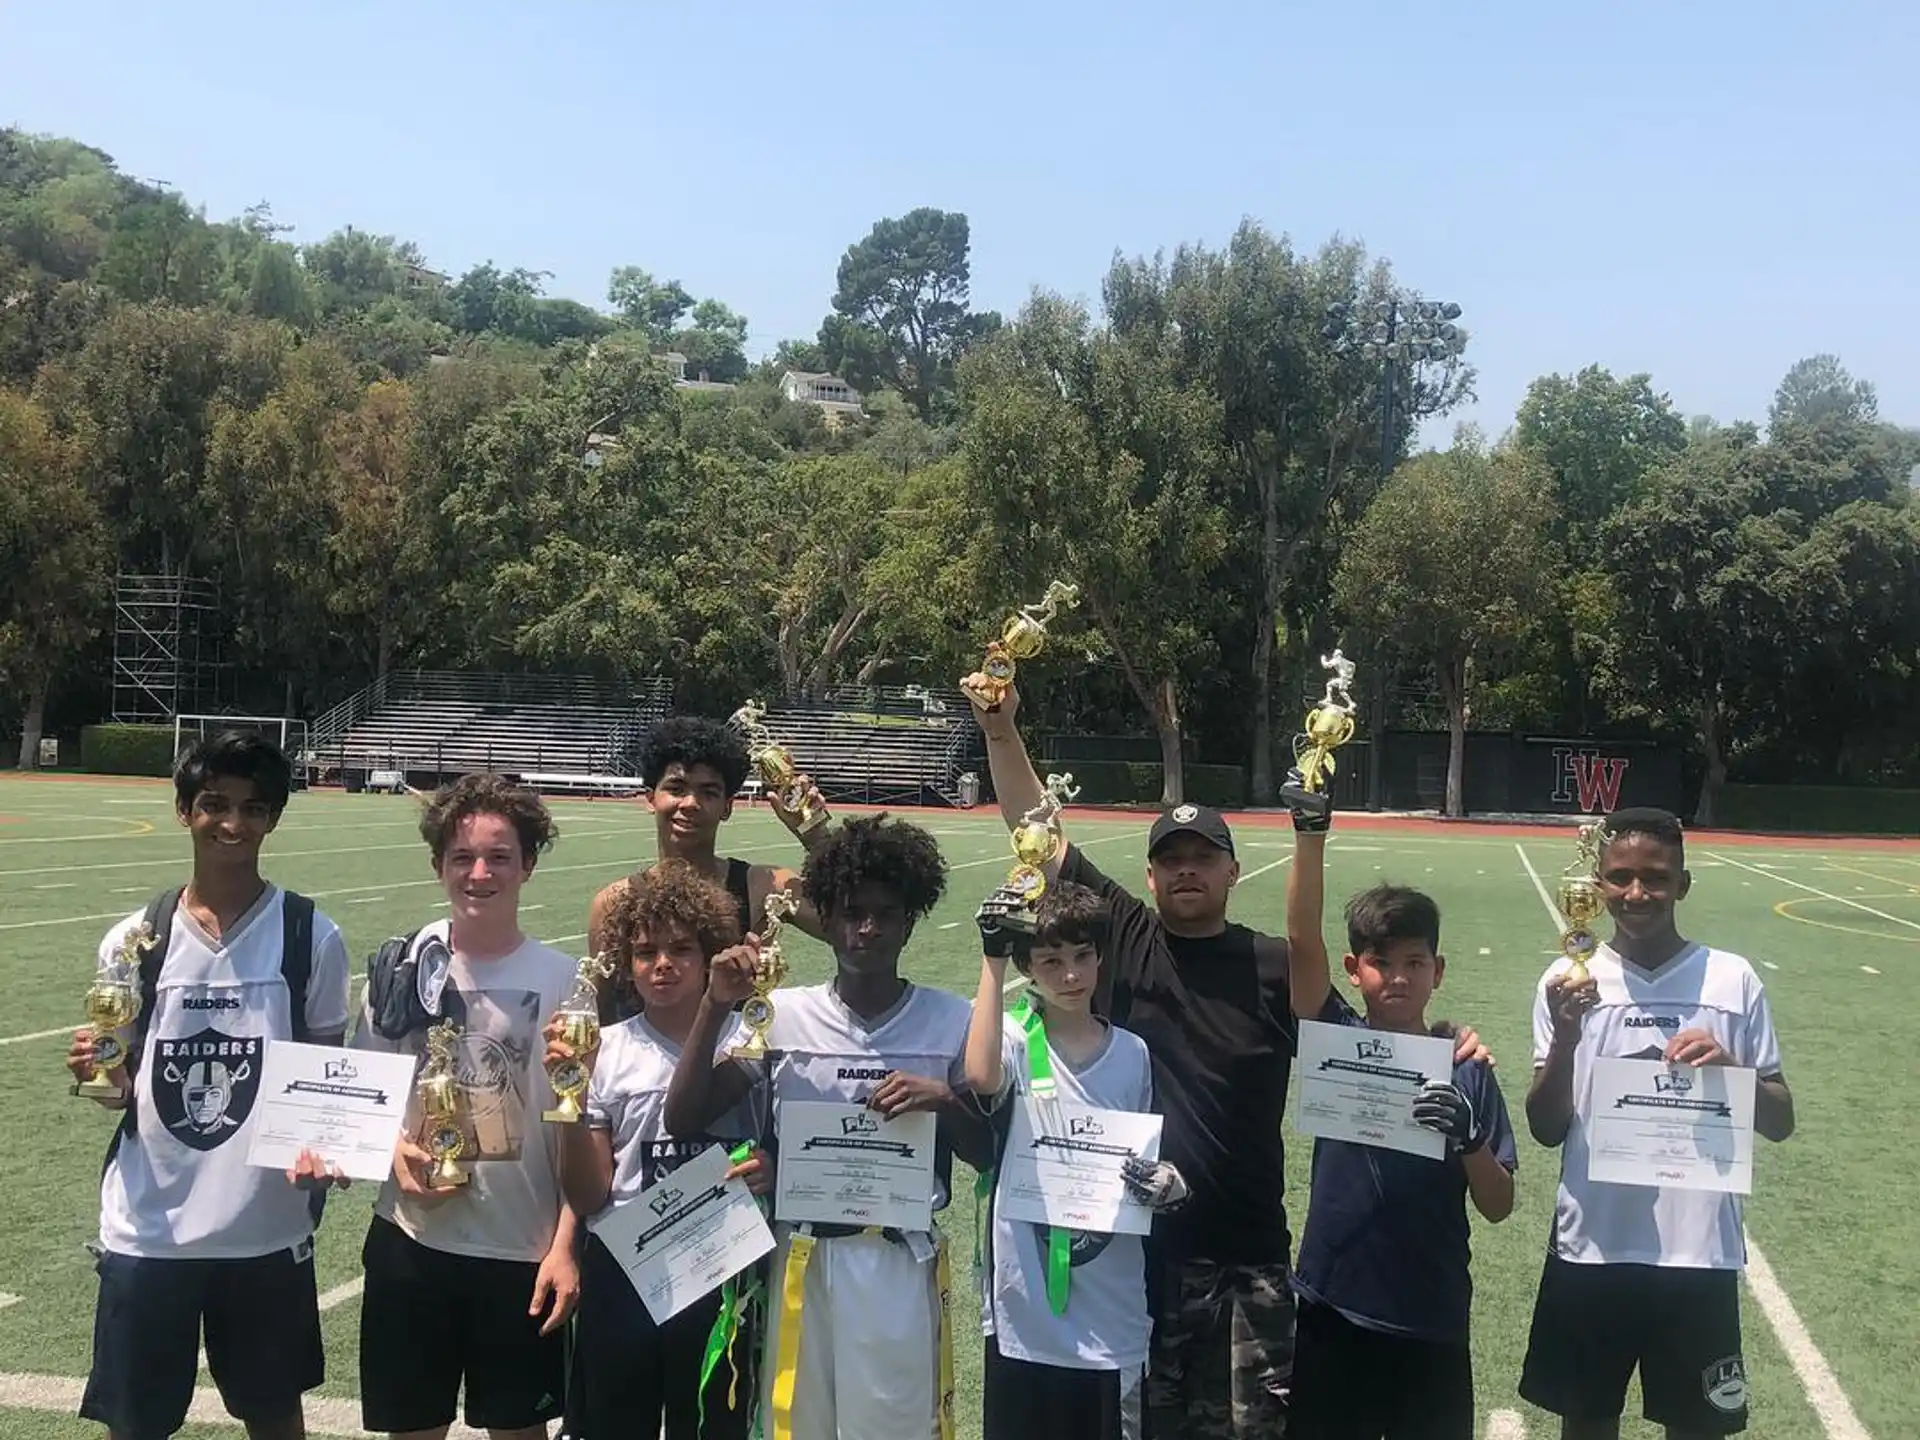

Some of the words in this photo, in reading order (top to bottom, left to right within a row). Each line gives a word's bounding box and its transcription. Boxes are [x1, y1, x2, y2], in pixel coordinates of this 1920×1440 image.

[1552, 747, 1629, 813] HW
[183, 998, 240, 1010] RAIDERS
[1624, 1017, 1681, 1028] RAIDERS
[162, 1041, 256, 1056] RAIDERS
[837, 1068, 896, 1080] RAIDER
